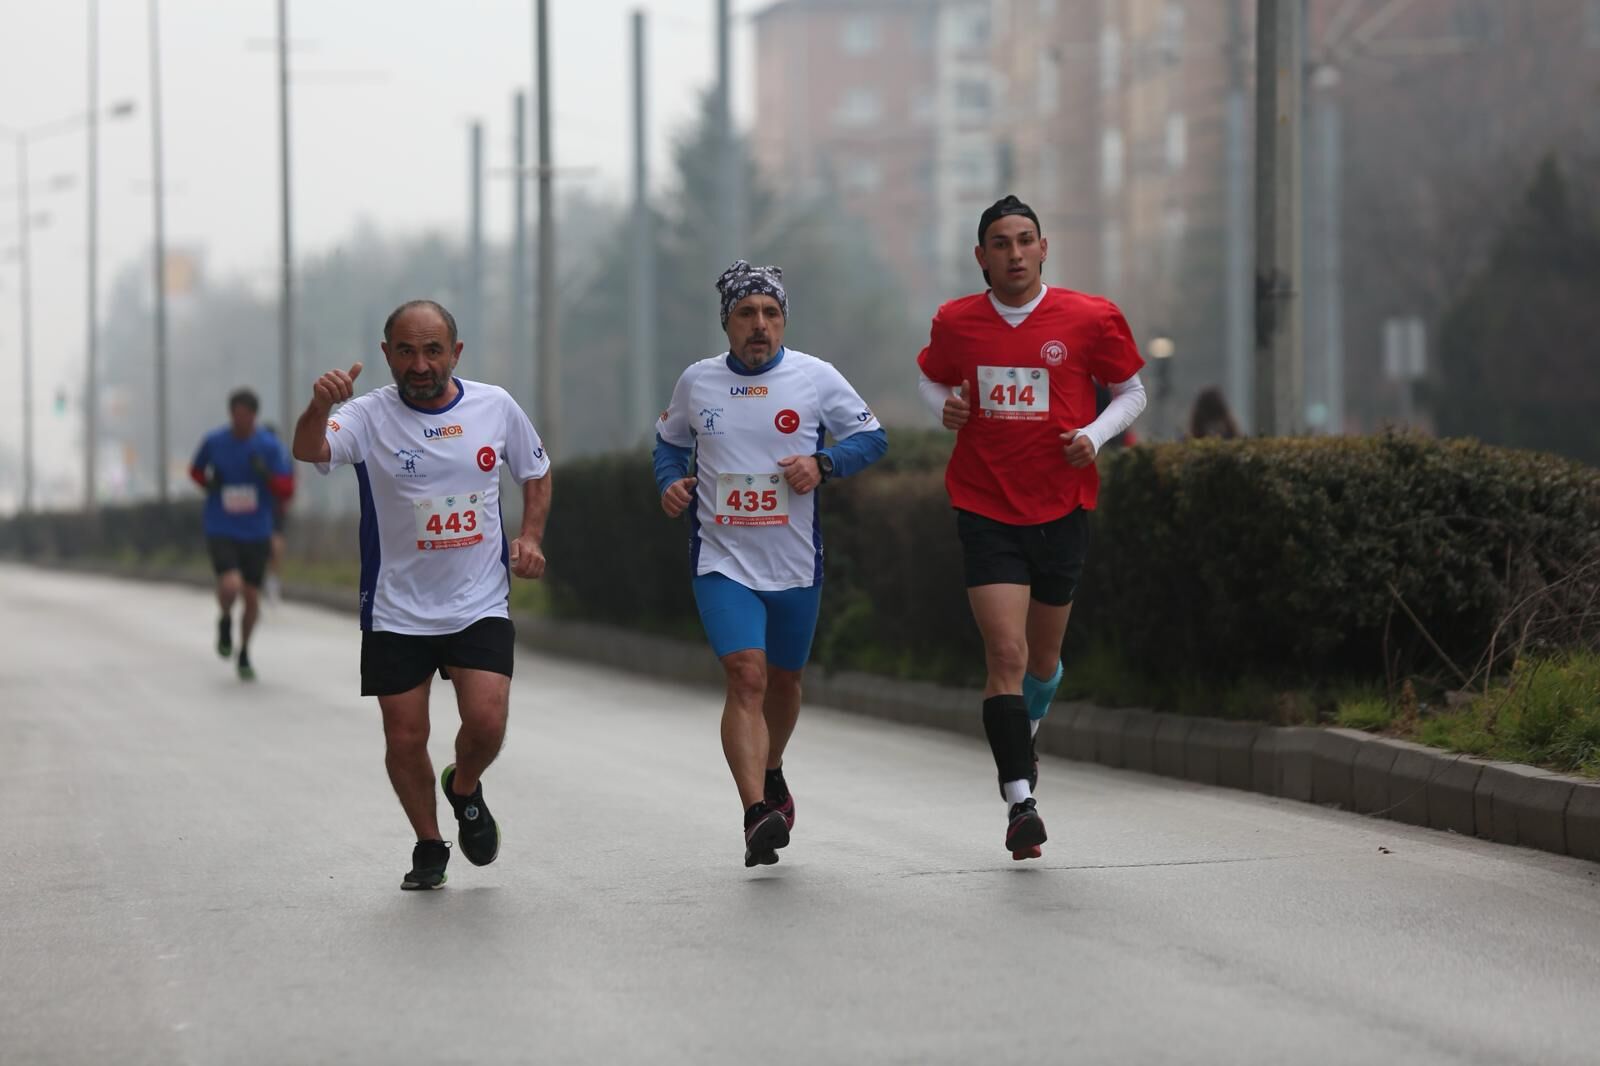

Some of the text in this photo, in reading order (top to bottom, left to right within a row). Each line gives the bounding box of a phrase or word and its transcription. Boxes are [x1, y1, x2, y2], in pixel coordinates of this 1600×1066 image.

[730, 386, 768, 396] UNIROB
[990, 384, 1035, 406] 414
[424, 425, 463, 438] UNIROB
[726, 490, 777, 512] 435
[426, 510, 476, 534] 443
